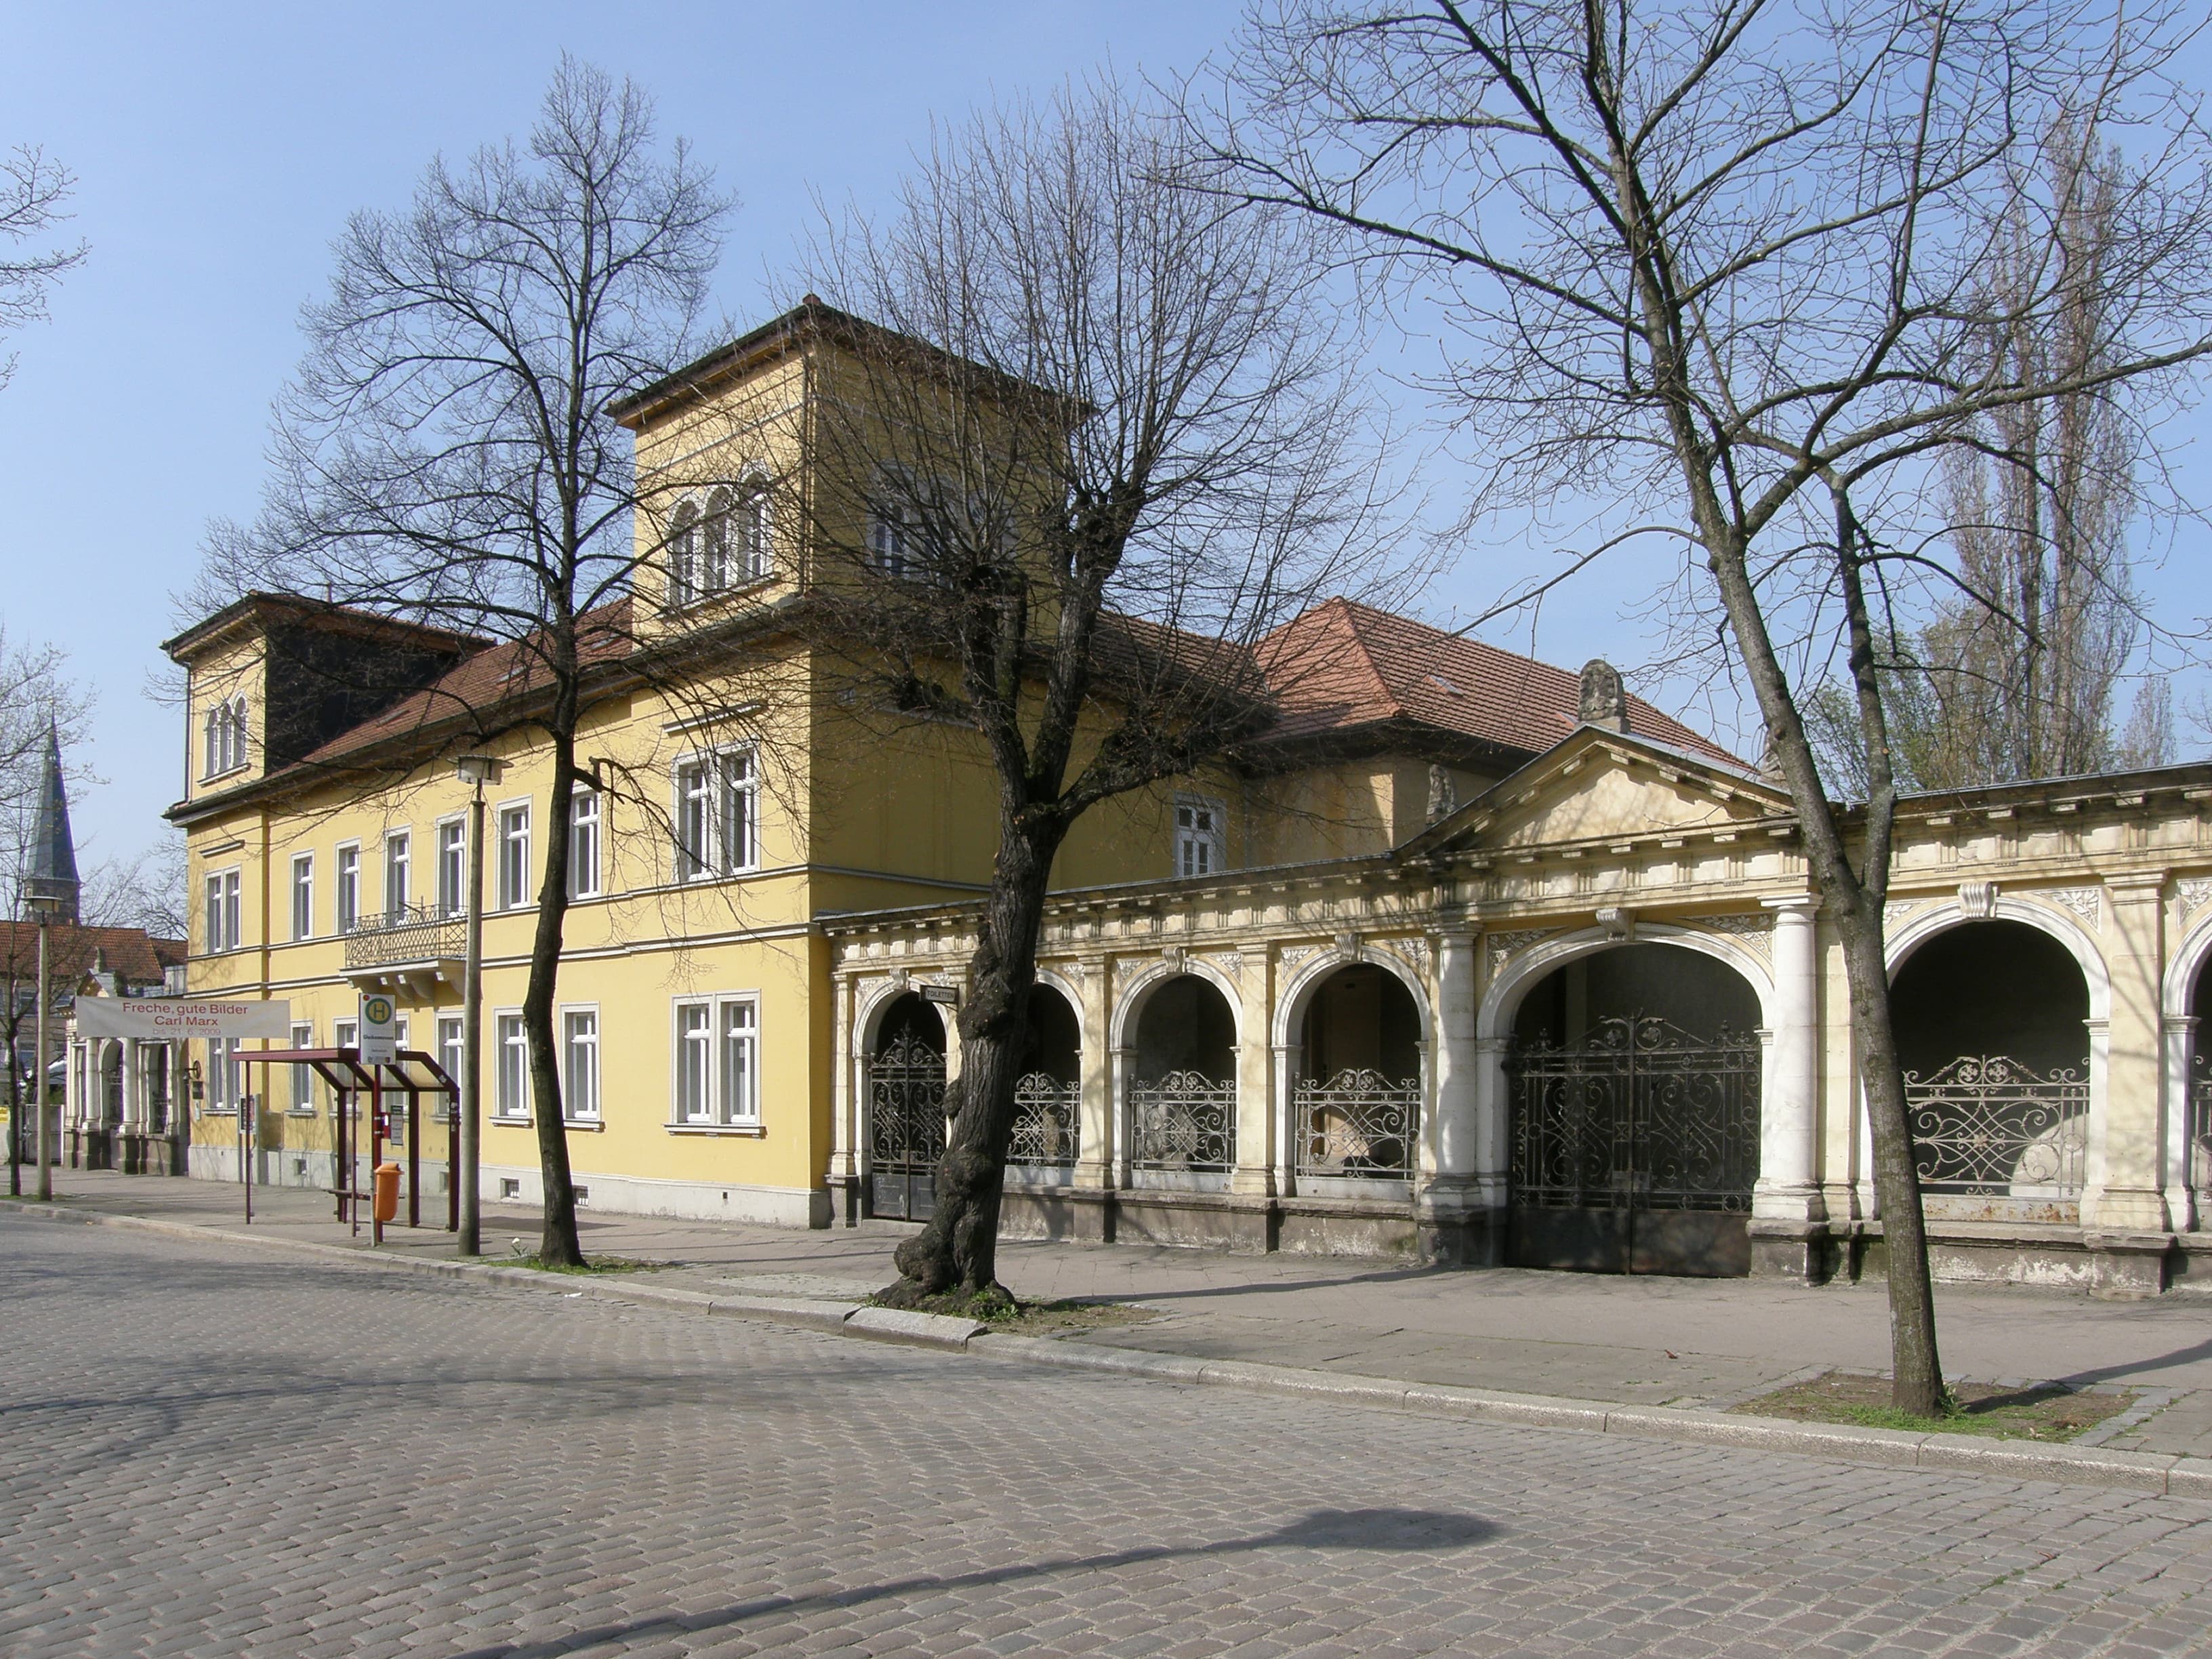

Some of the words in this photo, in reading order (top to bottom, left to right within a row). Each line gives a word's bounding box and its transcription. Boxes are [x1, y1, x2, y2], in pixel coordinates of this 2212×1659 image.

[926, 990, 954, 998] TOILETTEN
[122, 1002, 175, 1015] Freche,
[176, 1004, 207, 1016] gute
[209, 1004, 248, 1015] Bilder
[374, 1004, 385, 1019] H
[155, 1015, 182, 1025] Carl
[186, 1016, 218, 1025] Marx
